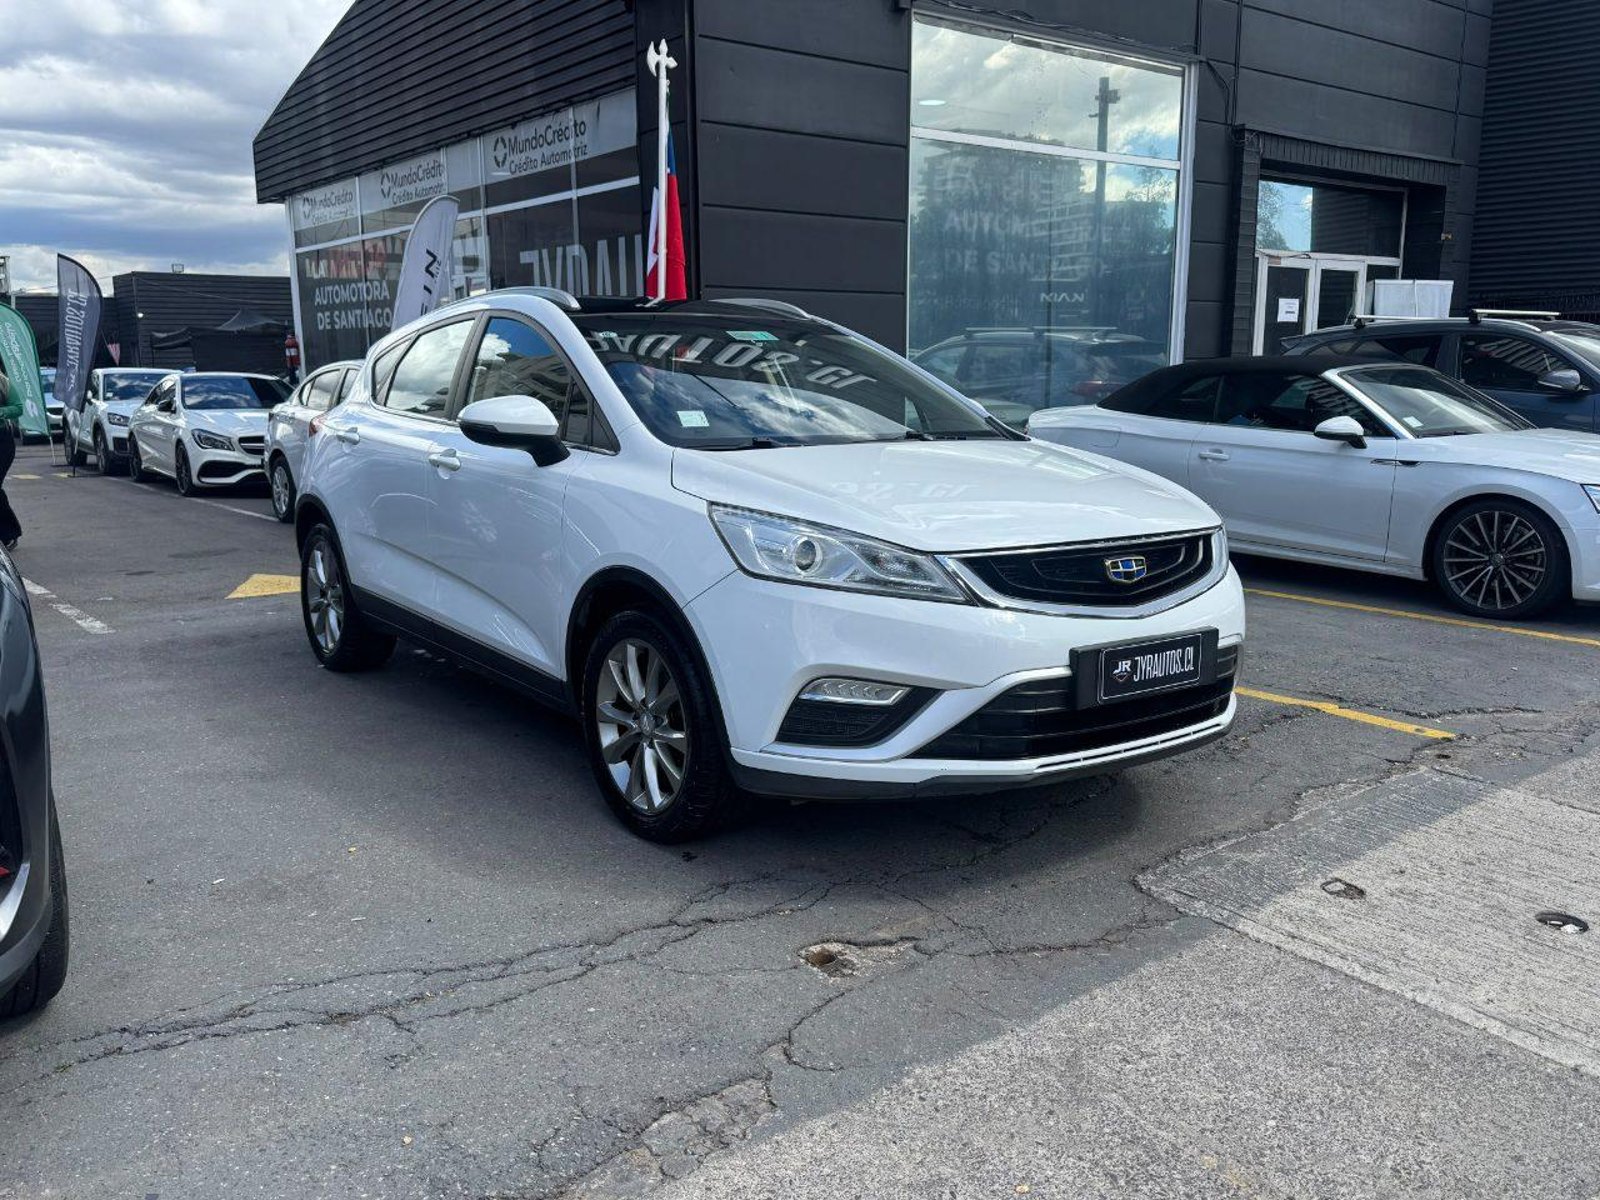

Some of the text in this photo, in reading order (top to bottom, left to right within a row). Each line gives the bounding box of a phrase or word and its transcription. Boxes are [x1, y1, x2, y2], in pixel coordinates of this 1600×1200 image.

[509, 155, 538, 175] Crédito
[314, 281, 390, 306] AUTOMOTORA
[317, 307, 393, 330] DE SANTIAGO
[1113, 646, 1194, 681] JR JYRAUTOS.CL
